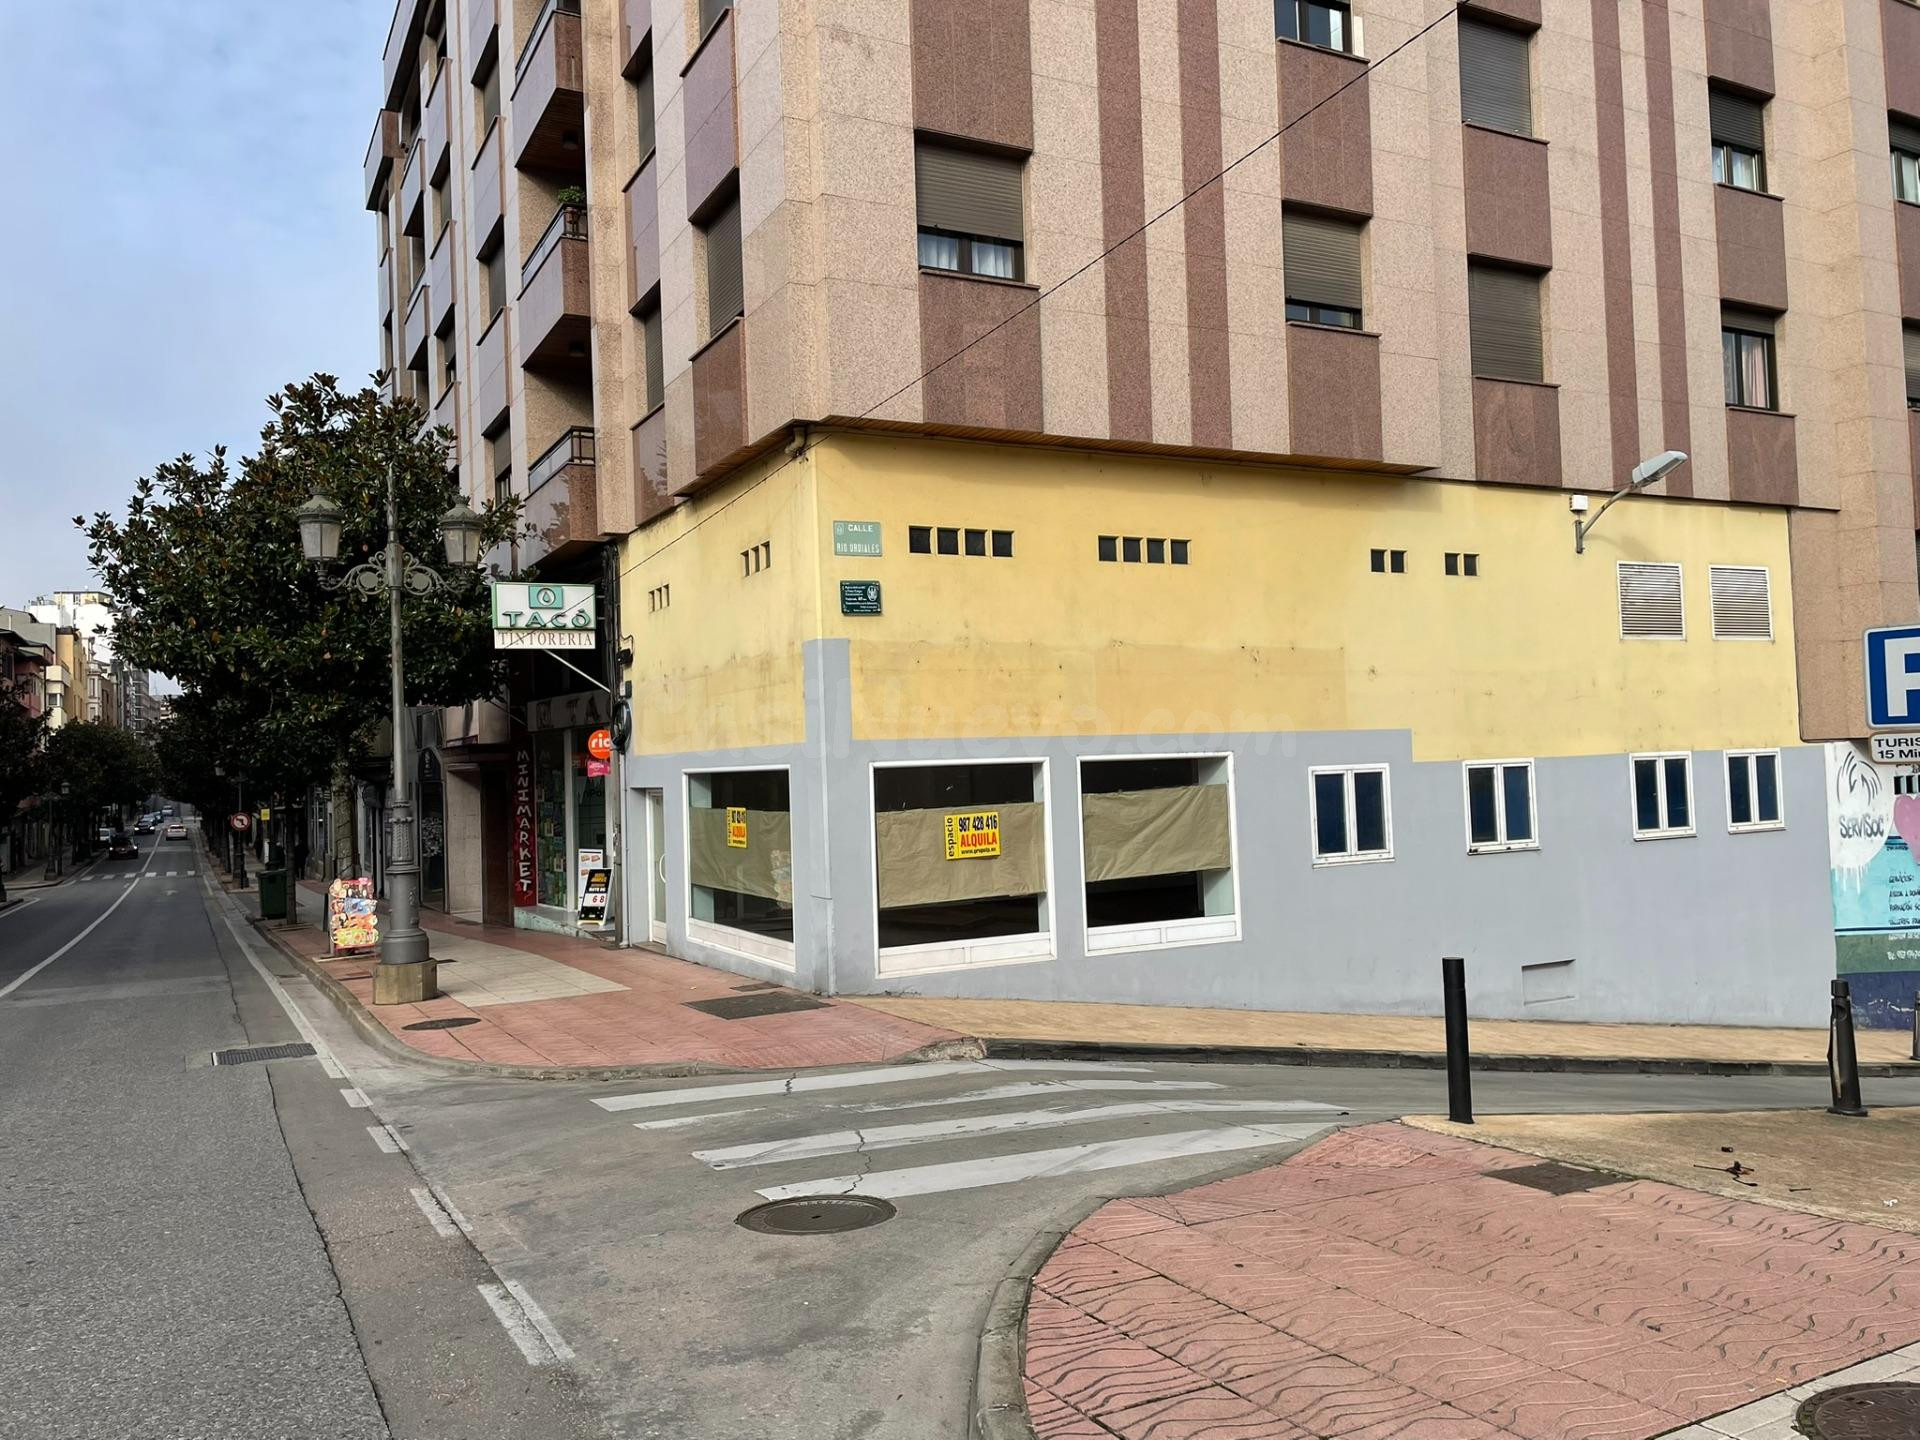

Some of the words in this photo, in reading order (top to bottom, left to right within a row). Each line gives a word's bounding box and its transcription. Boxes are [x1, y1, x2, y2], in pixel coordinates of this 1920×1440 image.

[848, 524, 873, 533] CALLE
[498, 631, 593, 646] TINTORERIA
[1878, 749, 1895, 759] 15
[517, 749, 532, 892] MINIMARKET
[985, 814, 997, 830] 416
[945, 817, 957, 857] espacio
[960, 831, 997, 848] ALQUILA
